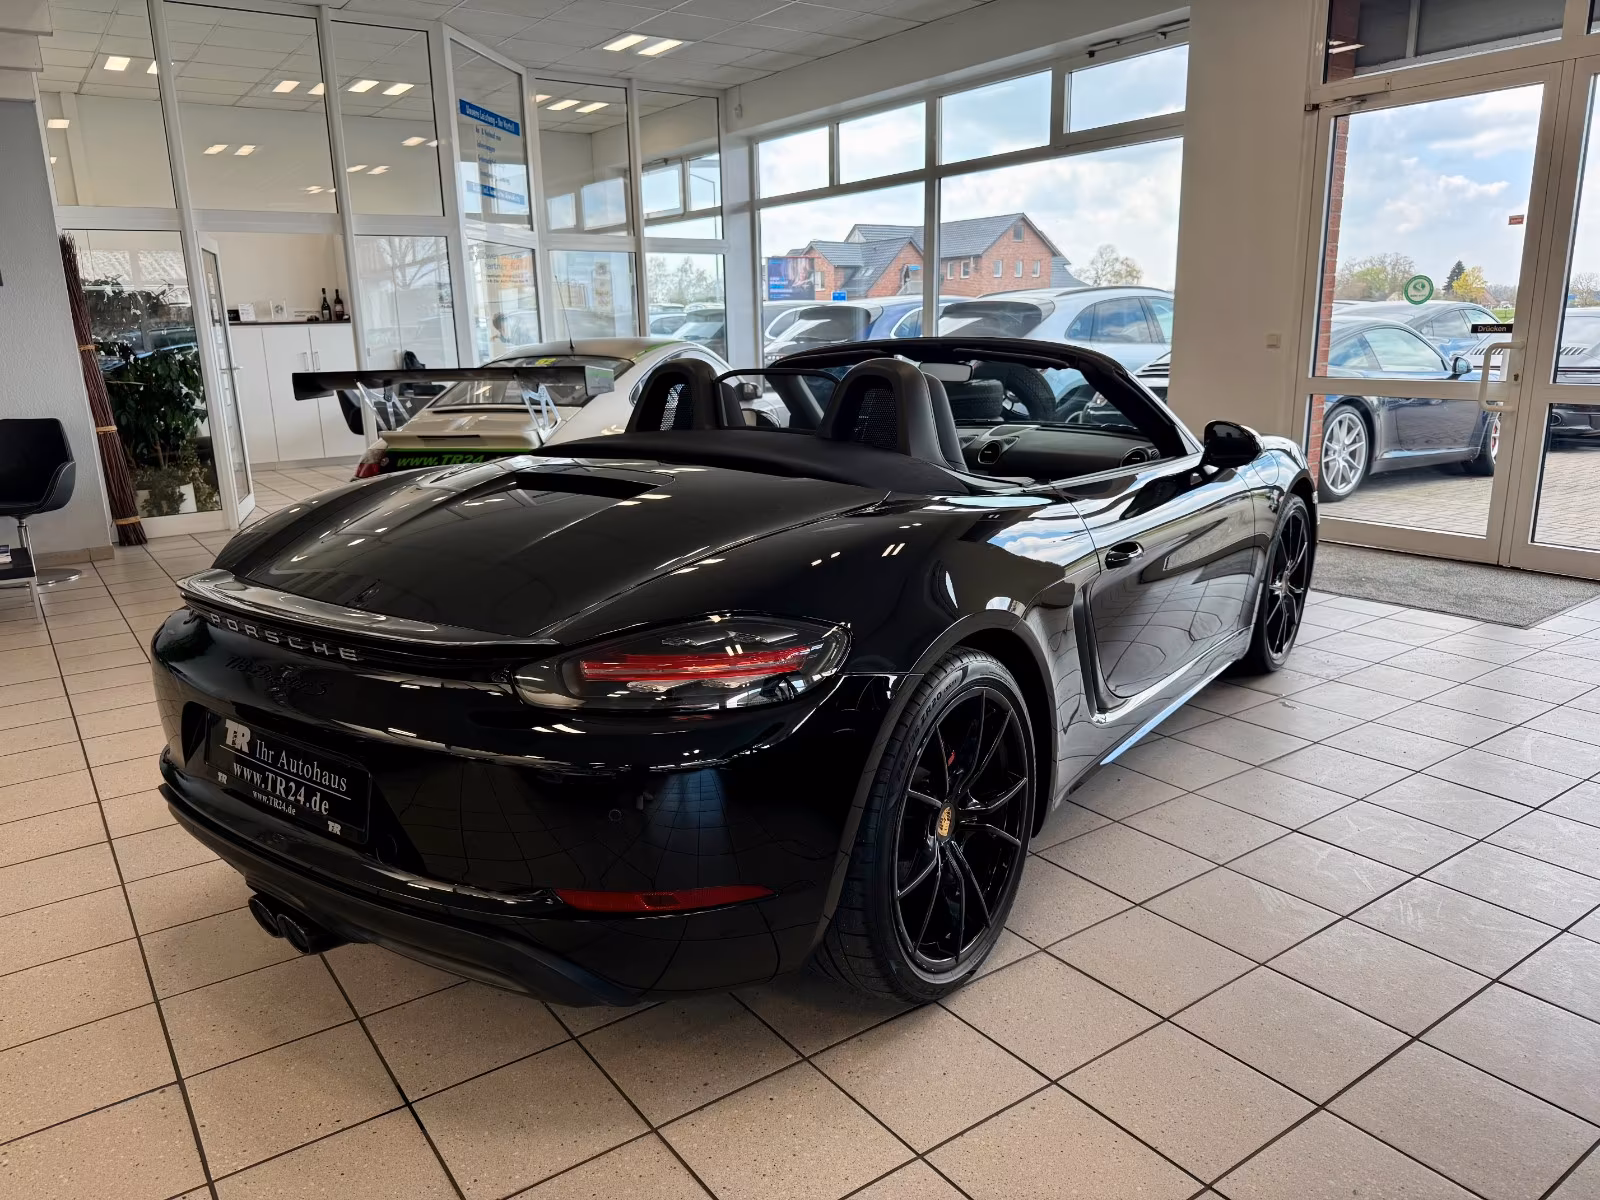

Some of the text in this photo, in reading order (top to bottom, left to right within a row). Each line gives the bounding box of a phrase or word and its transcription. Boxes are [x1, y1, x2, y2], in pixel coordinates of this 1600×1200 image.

[1477, 324, 1507, 333] Drücken
[211, 613, 358, 661] PORSCHE
[920, 690, 942, 725] ZR20
[225, 718, 251, 754] TR
[256, 739, 275, 764] Ihr
[277, 750, 347, 792] Autohaus
[217, 771, 228, 785] TR
[233, 762, 330, 815] www.TR24.de
[252, 790, 296, 816] www.TR24.de
[327, 820, 342, 836] TR
